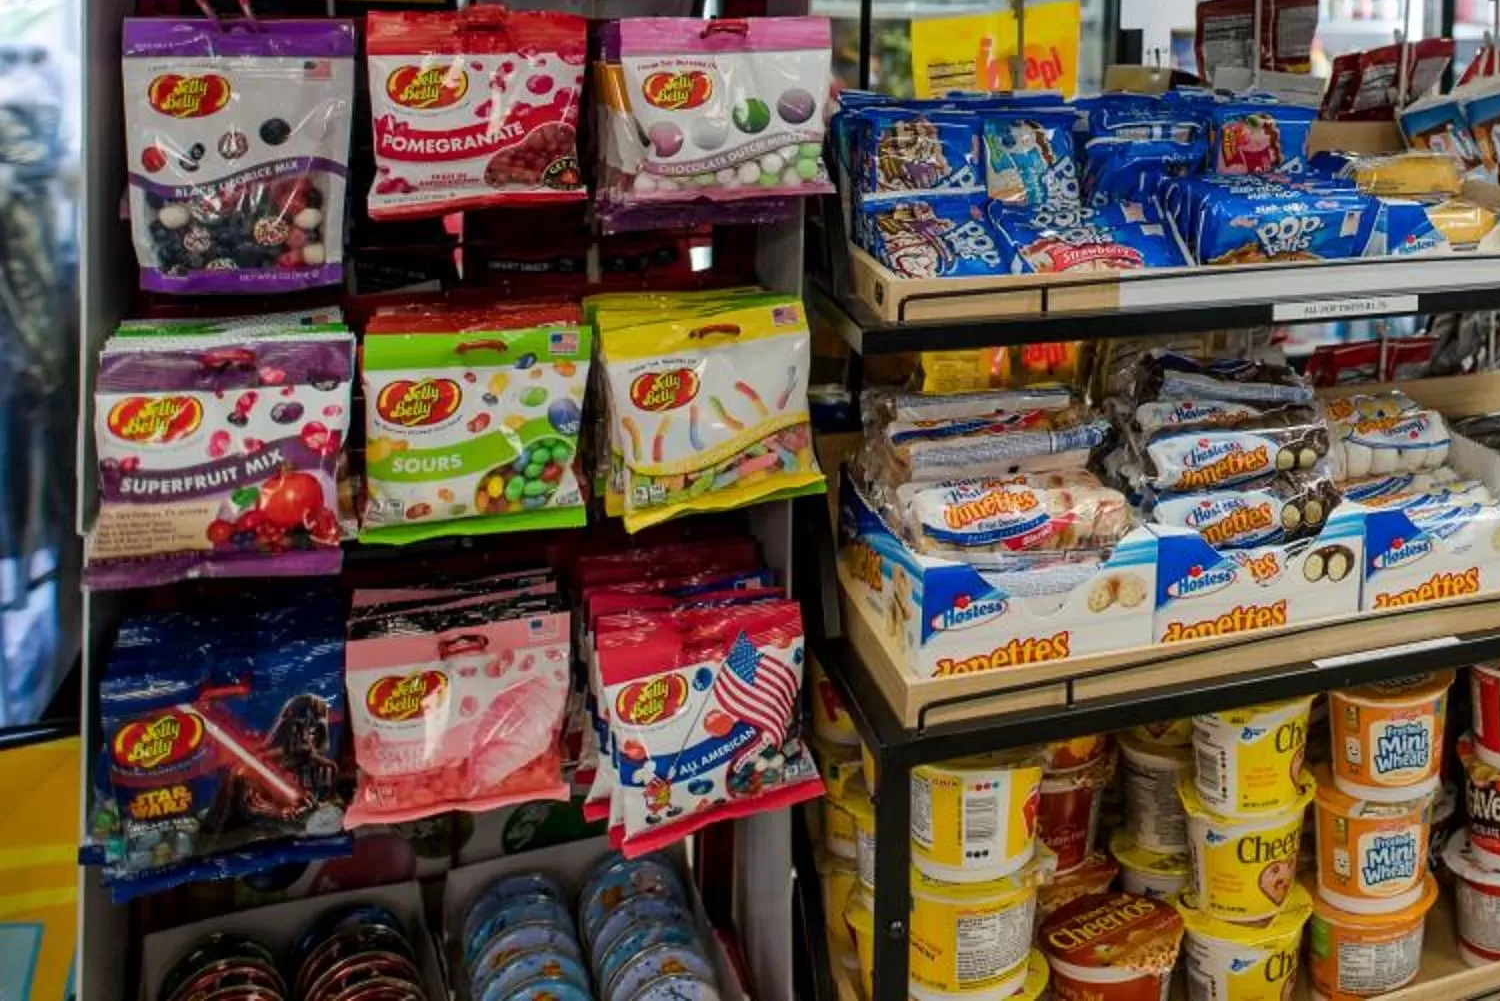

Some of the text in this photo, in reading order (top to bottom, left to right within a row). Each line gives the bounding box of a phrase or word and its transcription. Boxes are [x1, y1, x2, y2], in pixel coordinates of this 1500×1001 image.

[174, 76, 208, 97] Jelly
[665, 72, 692, 89] Jelly
[159, 94, 200, 117] Belly
[402, 86, 438, 108] Belly
[653, 86, 690, 108] Belly
[382, 120, 525, 153] POMEGRANATE
[274, 159, 298, 173] MIX
[659, 155, 727, 174] CHOCOLATE
[728, 142, 765, 162] DUTCH
[403, 380, 440, 403] Jelly
[652, 370, 682, 390] Jelly
[138, 398, 181, 419] Jelly
[643, 386, 676, 410] Belly
[389, 400, 431, 426] Belly
[121, 415, 169, 441] Belly
[119, 449, 285, 495] SUPERFRUIT MIX
[391, 454, 463, 474] SOURS
[1205, 502, 1274, 543] nettes
[1382, 541, 1429, 566] Hostess
[1177, 569, 1232, 594] Hostess
[941, 601, 1003, 629] Hostess
[391, 671, 427, 695] Jelly
[637, 676, 669, 701] Jelly
[379, 692, 420, 718] Belly
[629, 696, 665, 723] Belly
[143, 716, 181, 742] Jelly
[128, 738, 172, 767] Belly
[678, 726, 758, 777] ALL AMERICAN
[1378, 732, 1428, 756] Mini
[1375, 752, 1428, 774] Wheats
[138, 786, 192, 803] STAR
[129, 800, 191, 819] WARS
[1236, 828, 1301, 864] Cheer
[1367, 843, 1414, 867] Mini
[1363, 863, 1414, 886] Wheats
[1048, 898, 1158, 950] Cheerios
